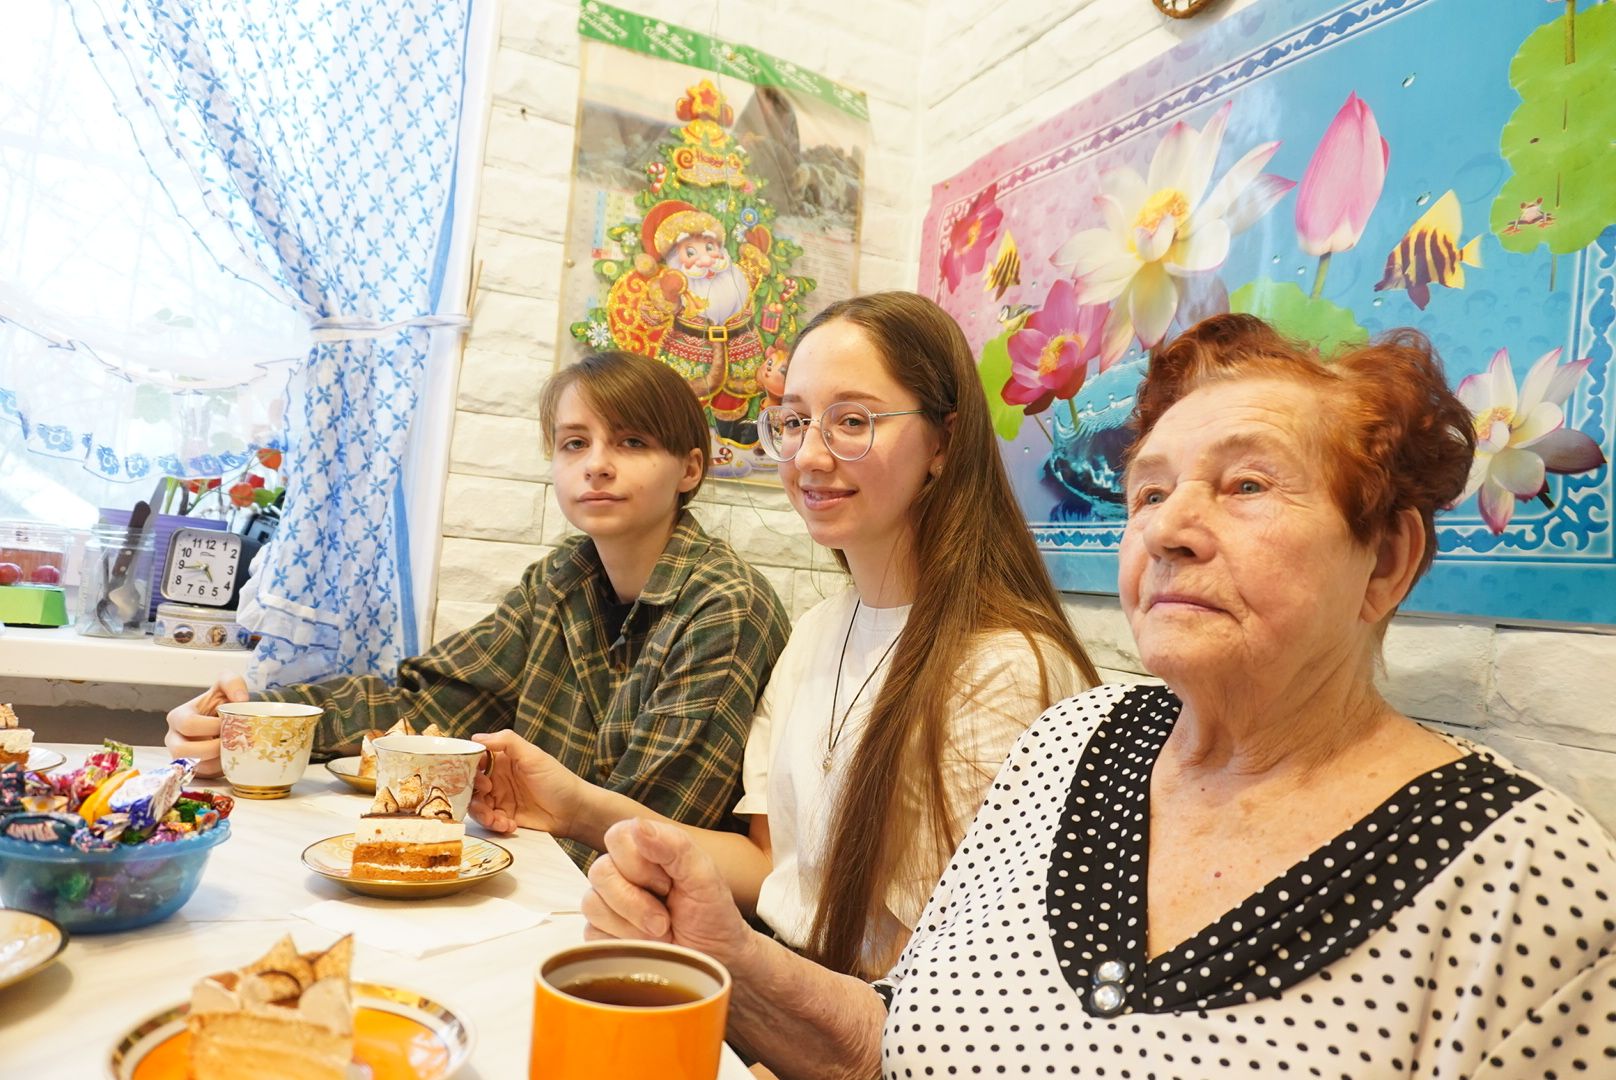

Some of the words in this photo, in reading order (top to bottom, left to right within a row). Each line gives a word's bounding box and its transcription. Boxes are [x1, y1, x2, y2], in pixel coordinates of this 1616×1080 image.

[193, 538, 202, 548] 11
[205, 540, 216, 550] 12
[223, 542, 228, 551] 1
[182, 547, 192, 557] 10
[230, 549, 237, 559] 2
[178, 560, 184, 569] 9
[227, 566, 234, 575] 3
[175, 575, 182, 585] 8
[187, 584, 193, 593] 7
[198, 586, 205, 595] 6
[223, 581, 230, 591] 4
[211, 587, 218, 597] 5
